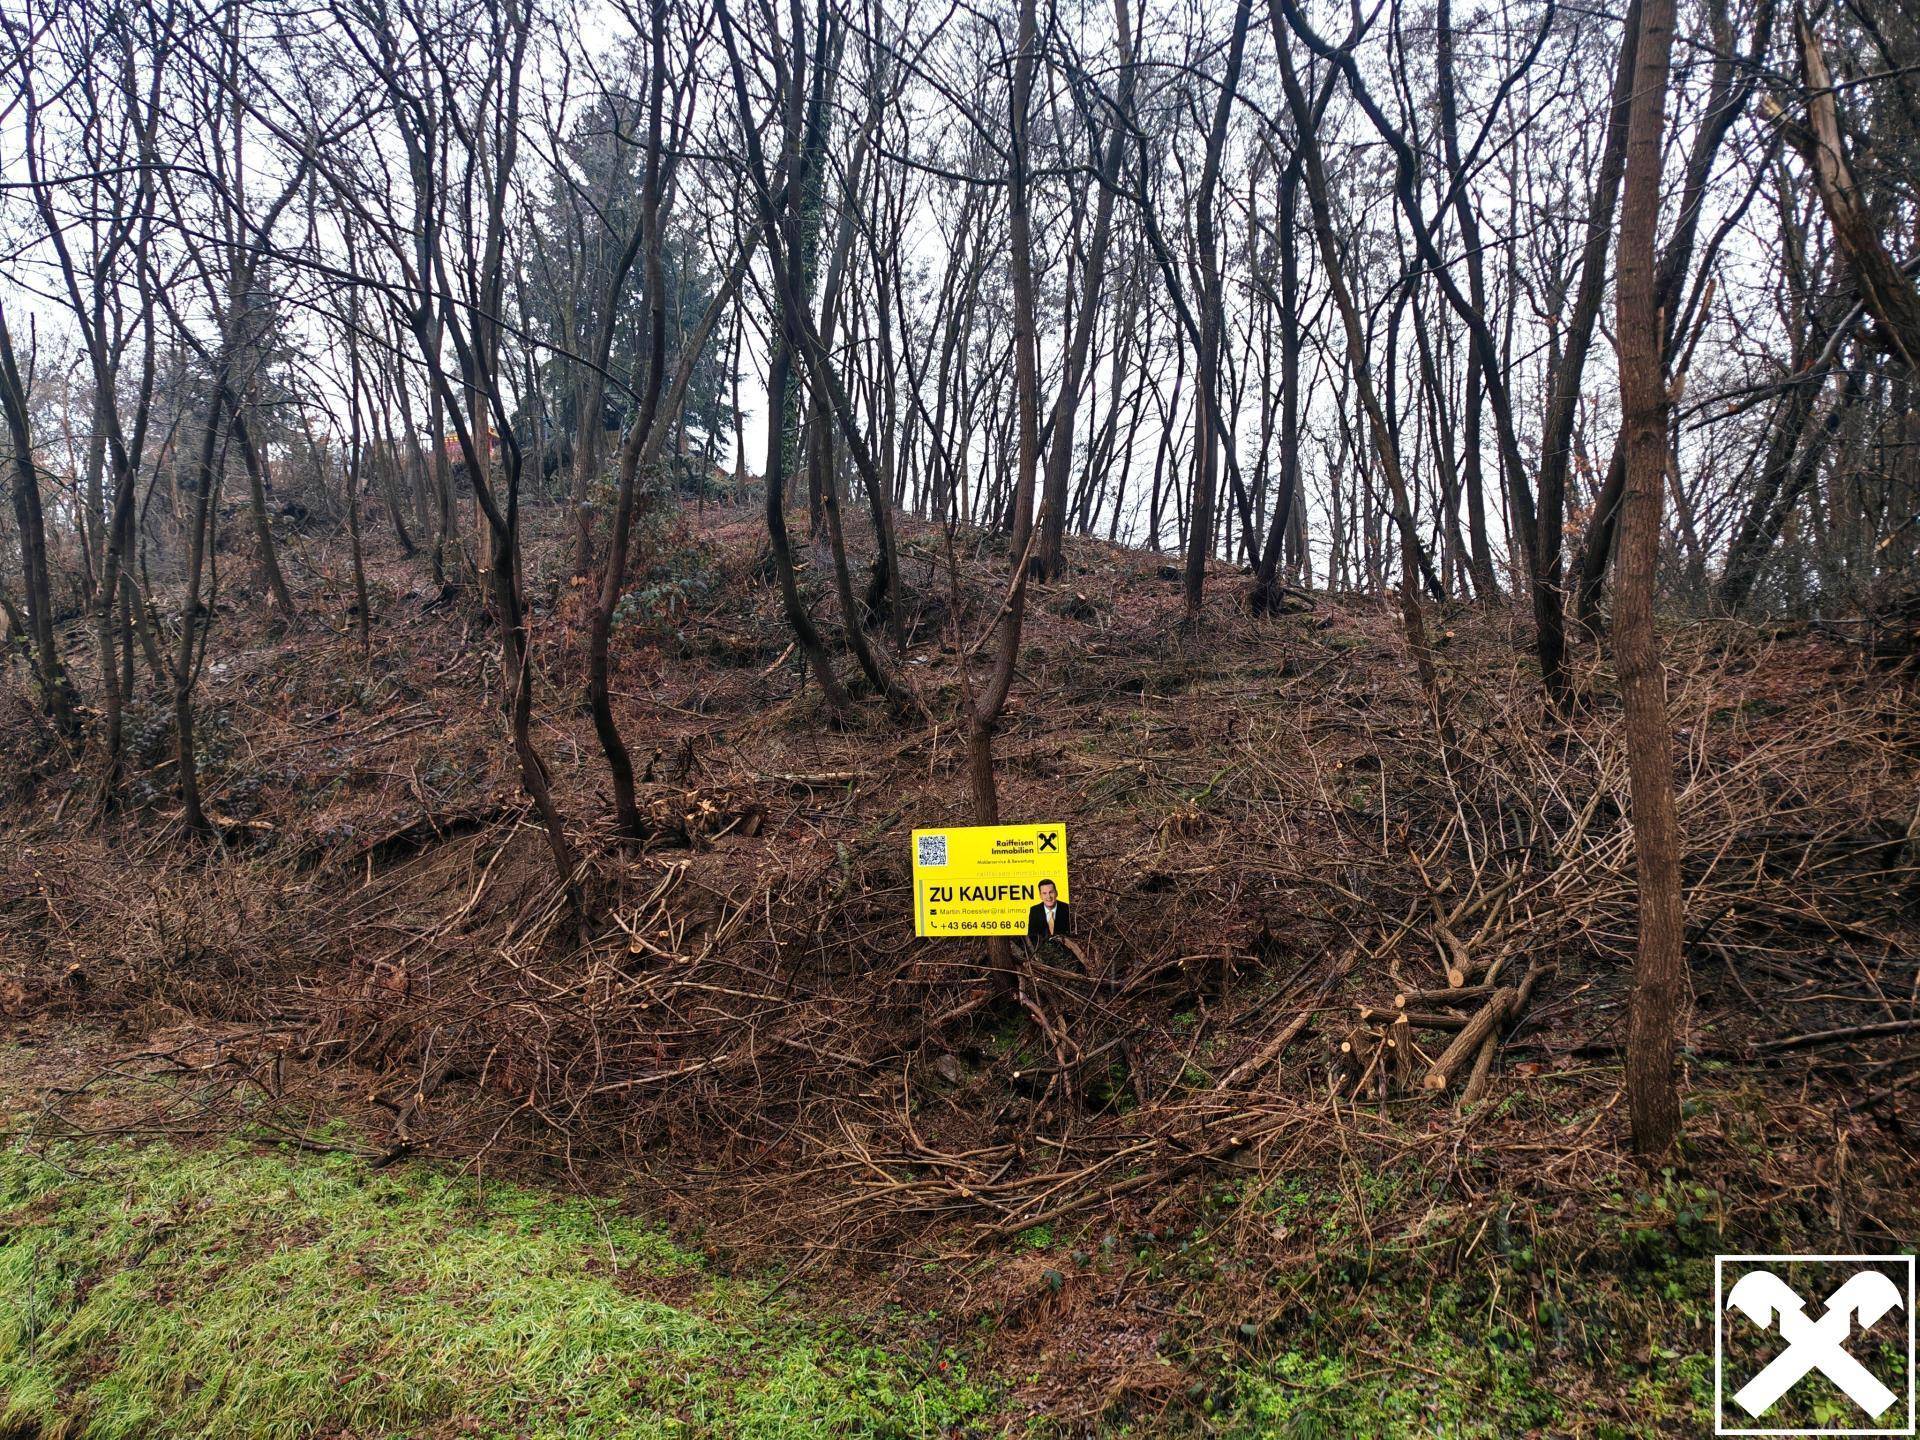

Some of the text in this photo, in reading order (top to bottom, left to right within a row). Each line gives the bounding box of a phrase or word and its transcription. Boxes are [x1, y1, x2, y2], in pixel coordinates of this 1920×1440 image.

[991, 847, 1034, 855] Immobilien
[929, 885, 1034, 902] ZU KAUFEN
[941, 920, 1026, 930] +43 664 450 68 40
